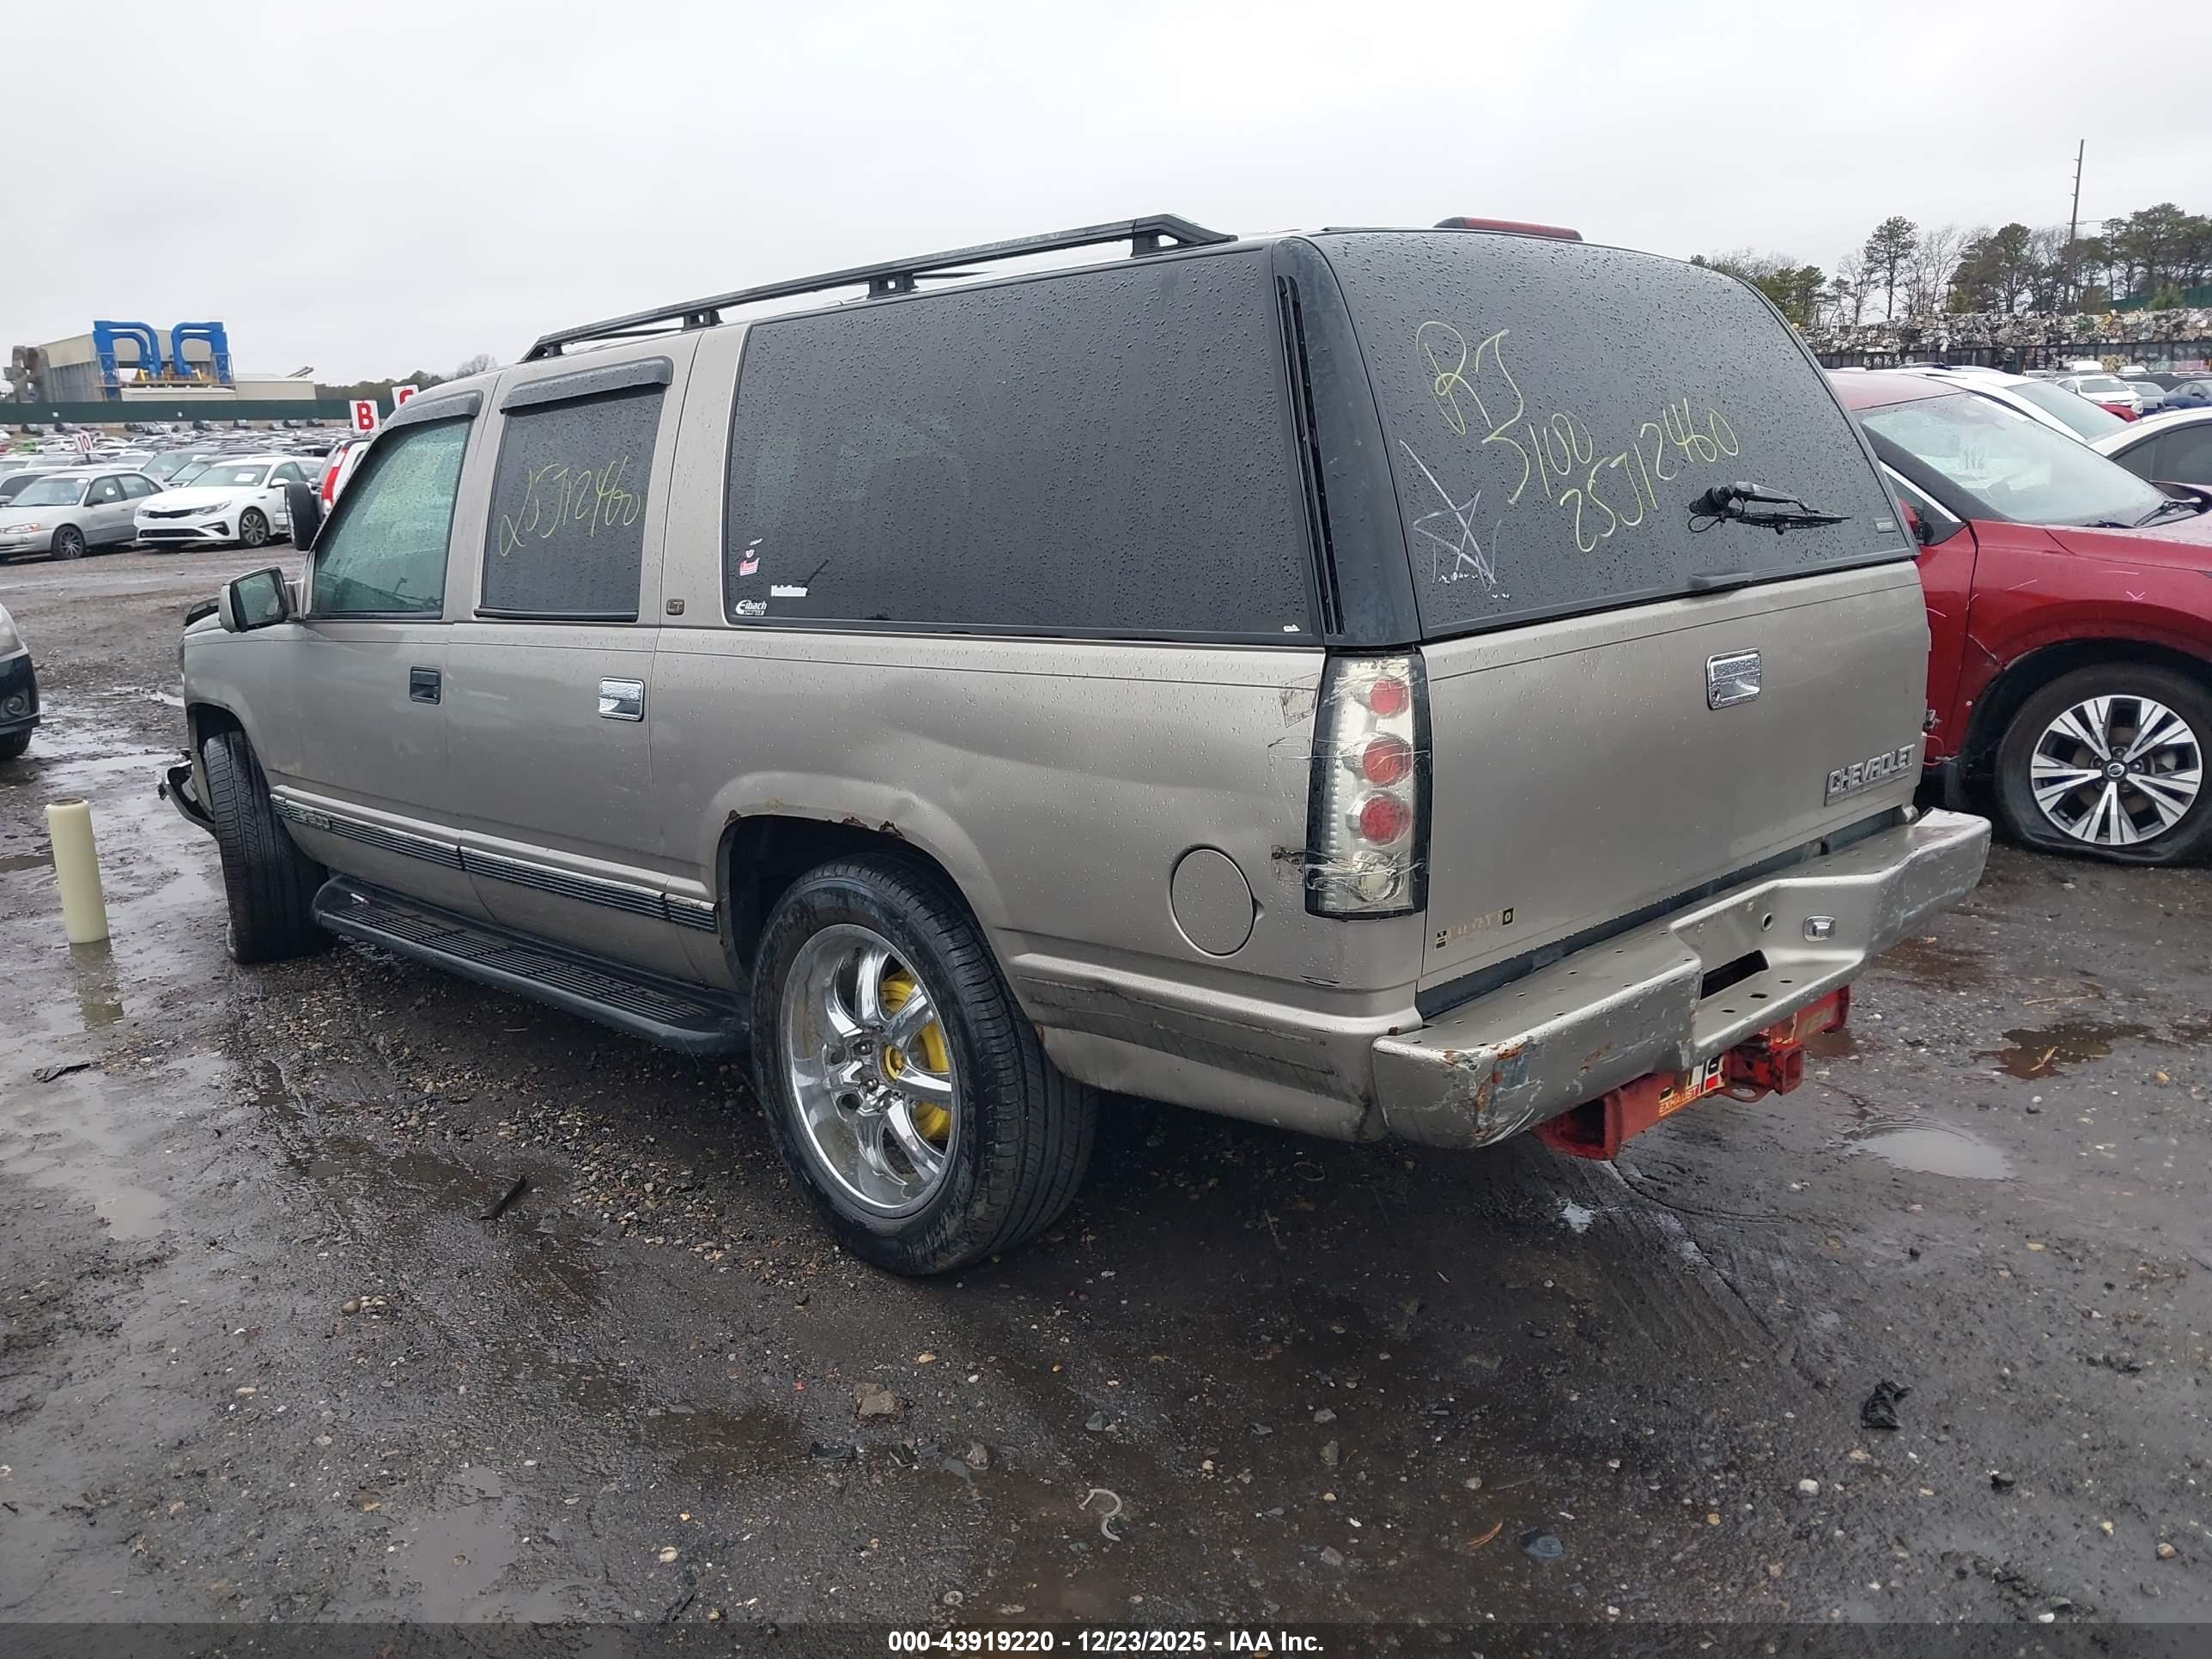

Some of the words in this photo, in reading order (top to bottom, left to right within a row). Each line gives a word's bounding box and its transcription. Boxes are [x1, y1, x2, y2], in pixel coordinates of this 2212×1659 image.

[356, 403, 374, 429] B
[77, 434, 91, 453] 10
[667, 601, 684, 612] LT
[735, 599, 768, 616] Eibach
[1829, 743, 1916, 793] CHEVROLET
[1659, 1085, 1698, 1114] EXHAUST
